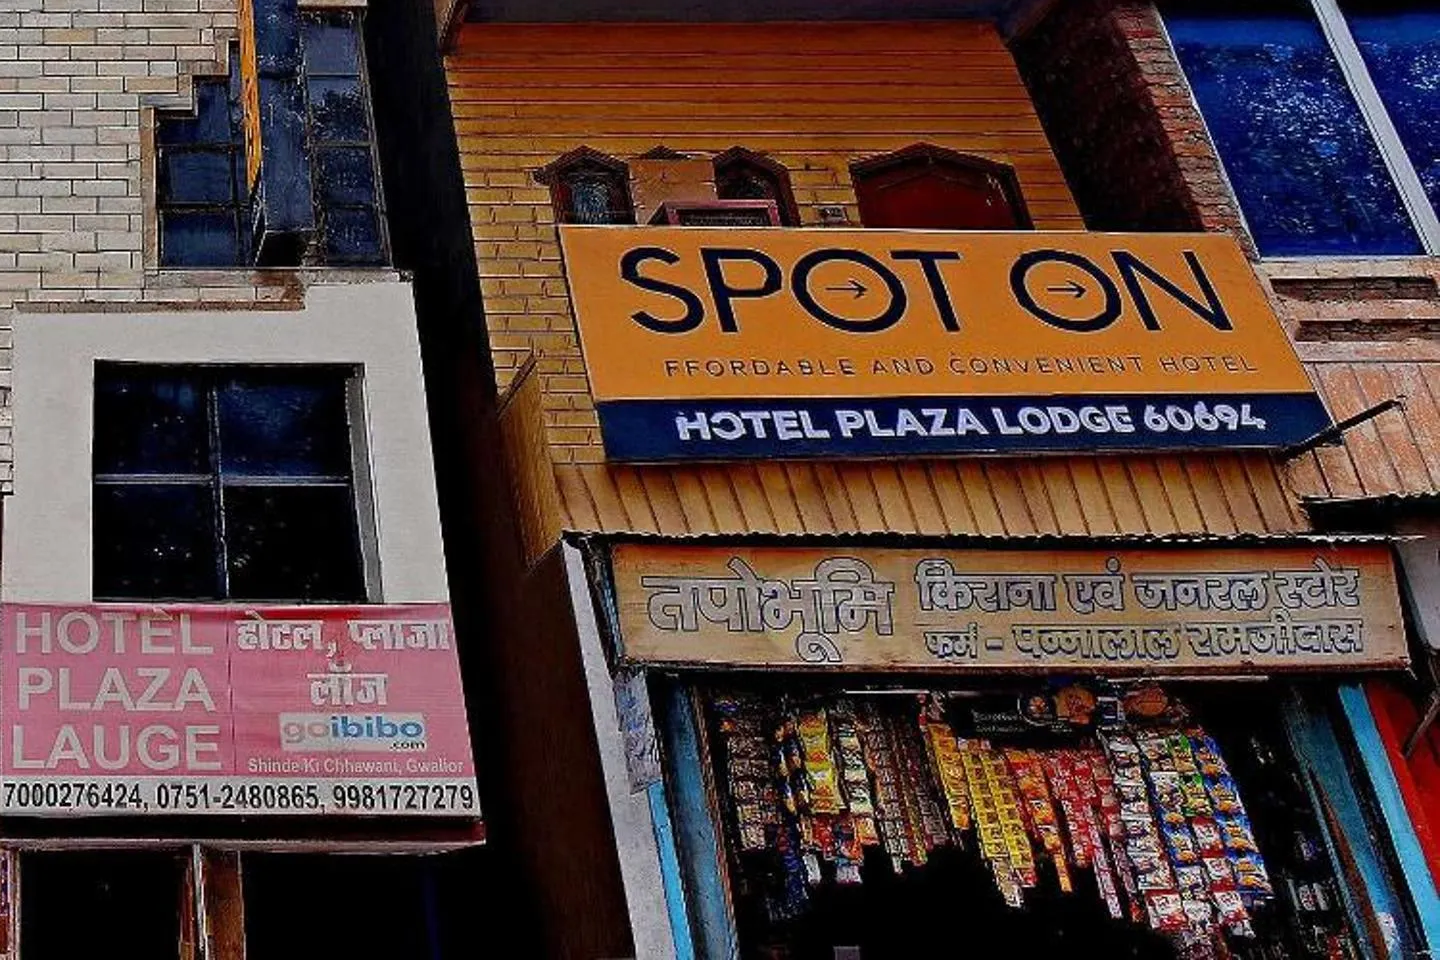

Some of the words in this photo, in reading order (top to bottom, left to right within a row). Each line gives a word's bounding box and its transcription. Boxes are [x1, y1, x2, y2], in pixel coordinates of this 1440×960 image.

[619, 246, 963, 334] SPOT
[1009, 248, 1234, 333] ON
[872, 358, 935, 376] AND
[948, 356, 1143, 374] CONVENIENT
[1159, 355, 1259, 374] HOTEL
[675, 409, 830, 440] HOTEL
[835, 407, 989, 438] PLAZA
[992, 404, 1136, 435] LODGE
[1144, 401, 1266, 433] 60694
[914, 558, 1057, 613] किराना
[1063, 556, 1126, 614] एवं
[1131, 571, 1270, 612] जनरल
[1273, 555, 1360, 609] स्टोर
[641, 556, 895, 662] तपोभूमि
[15, 612, 215, 656] HOTEL
[235, 611, 337, 658] होटल,
[923, 621, 978, 659] फर्म
[1012, 623, 1181, 660] पन्नालाल
[17, 666, 216, 712] PLAZA
[307, 658, 389, 706] लॉज
[12, 724, 222, 772] LAUGE
[283, 715, 424, 744] goibibo
[389, 740, 425, 750] .com
[406, 758, 464, 774] Gwalior
[3, 782, 148, 812] 7000276424,
[157, 784, 325, 814] 0751-2480865,
[333, 784, 474, 810] 9981727279
